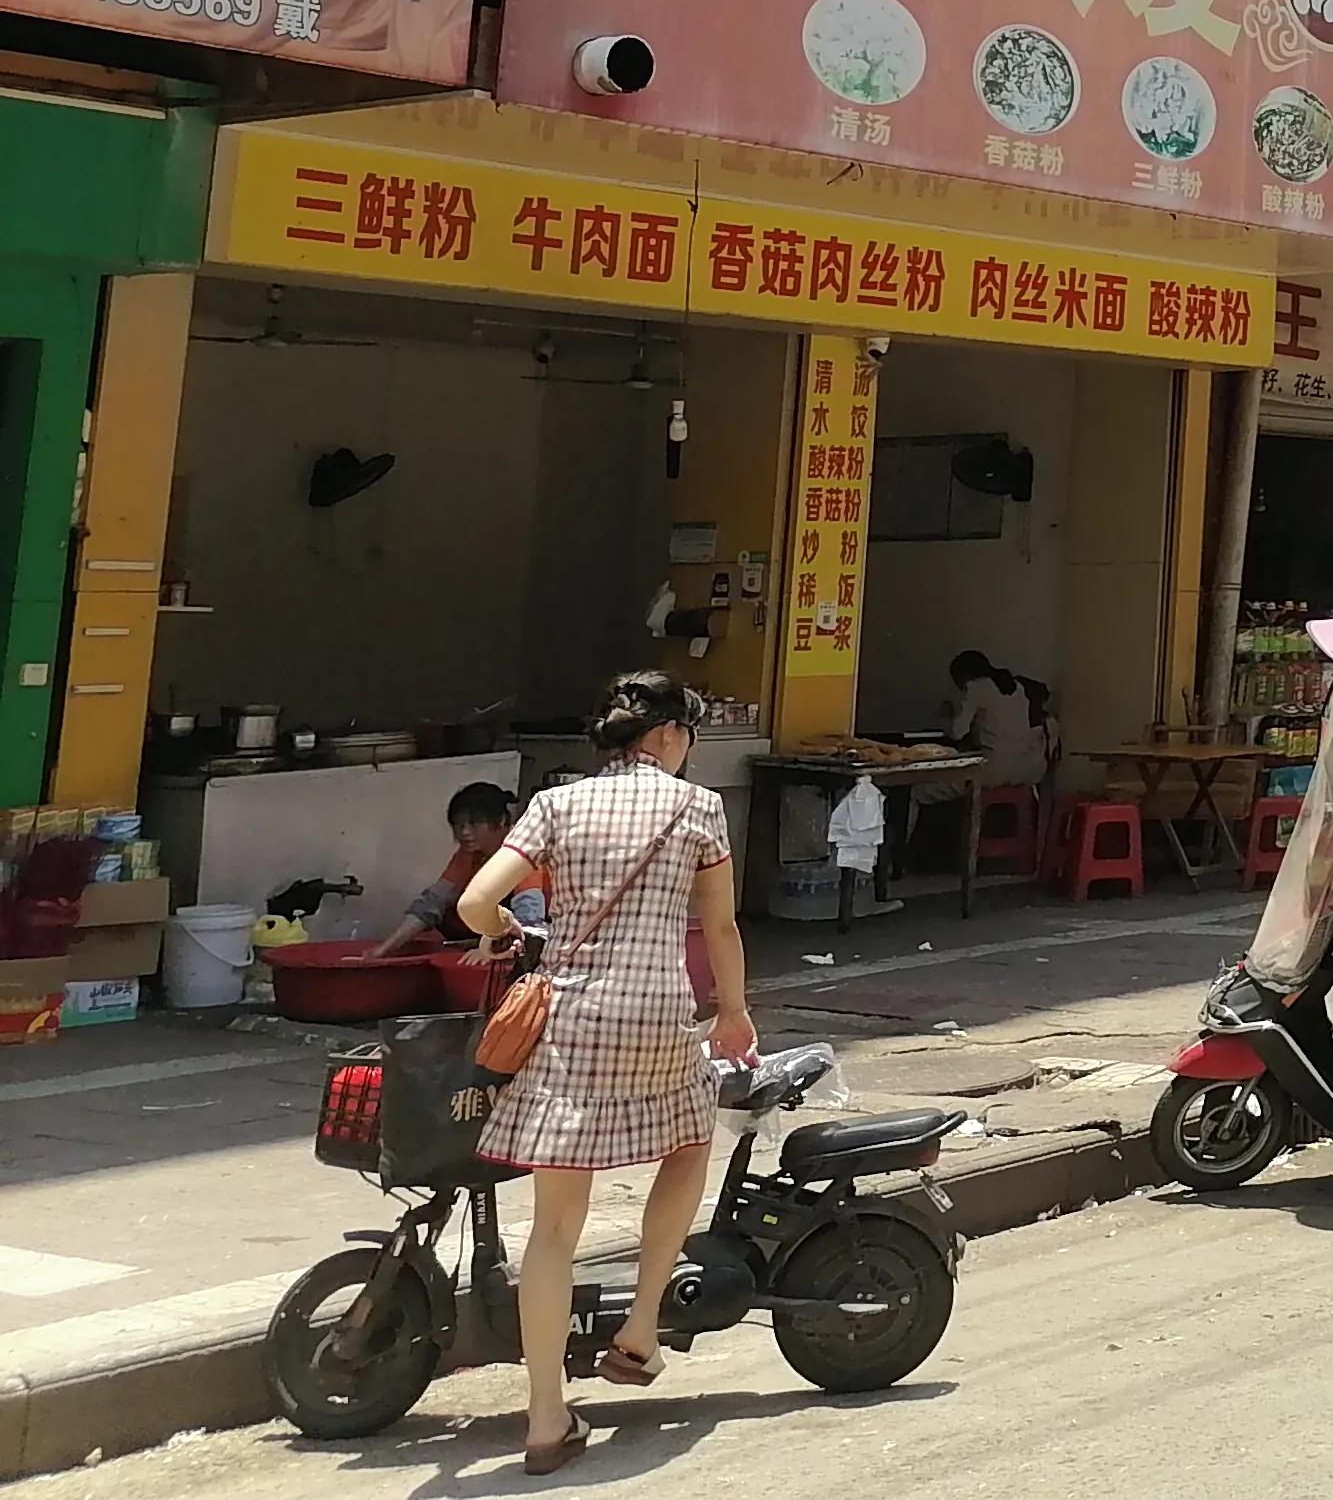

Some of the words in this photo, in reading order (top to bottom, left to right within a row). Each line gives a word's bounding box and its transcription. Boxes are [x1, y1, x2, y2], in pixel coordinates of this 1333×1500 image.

[830, 106, 893, 147] 清汤
[984, 134, 1065, 178] 香菇粉
[1130, 160, 1203, 201] 三鲜粉
[1261, 183, 1326, 221] 酸辣粉
[286, 165, 478, 262] 三鲜粉
[511, 195, 677, 285] 牛肉面
[707, 223, 946, 315] 香菇肉丝粉
[970, 256, 1128, 334] 肉丝米面
[1147, 280, 1252, 348] 酸辣粉
[807, 444, 865, 481] 酸辣粉
[805, 486, 862, 523] 香菇粉
